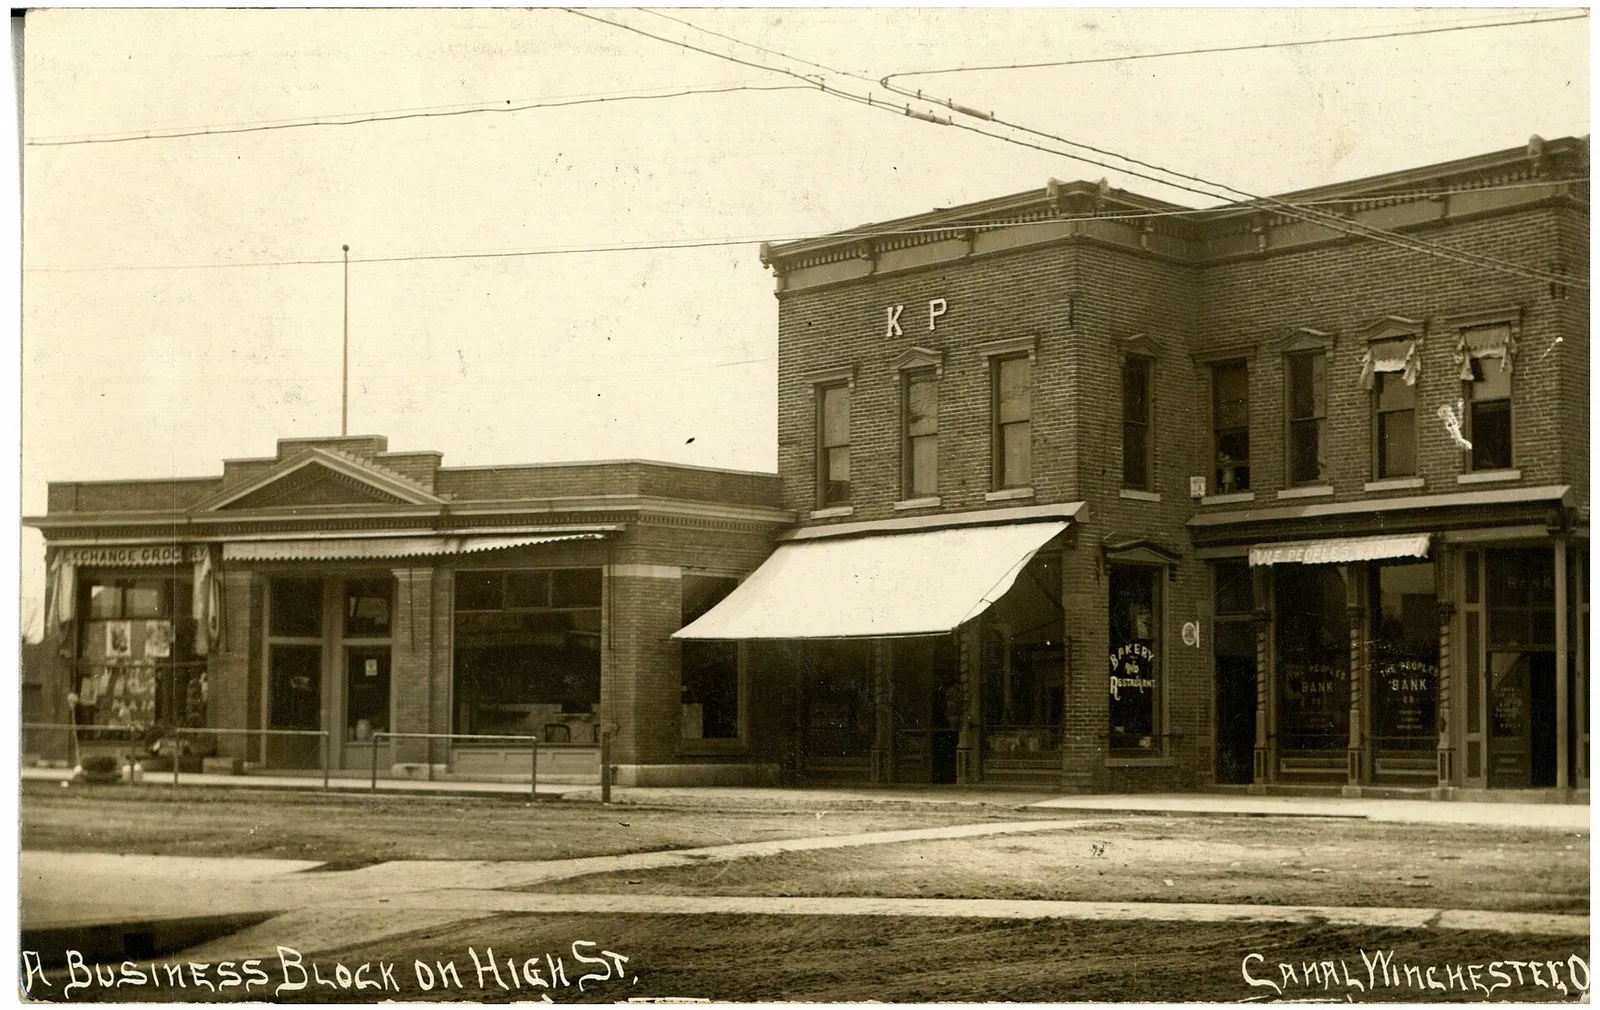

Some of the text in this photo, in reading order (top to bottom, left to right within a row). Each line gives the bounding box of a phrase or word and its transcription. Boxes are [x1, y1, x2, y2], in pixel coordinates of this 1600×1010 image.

[887, 298, 947, 337] K P
[62, 545, 208, 563] EXCHANGE GROCRY
[1256, 541, 1393, 562] THE PEOPLES BAN
[1109, 643, 1155, 671] BAKERY
[1399, 661, 1439, 677] PEOPLES
[1109, 676, 1156, 701] RESTAURANT
[1301, 681, 1334, 693] BANK
[1391, 678, 1427, 692] BANK
